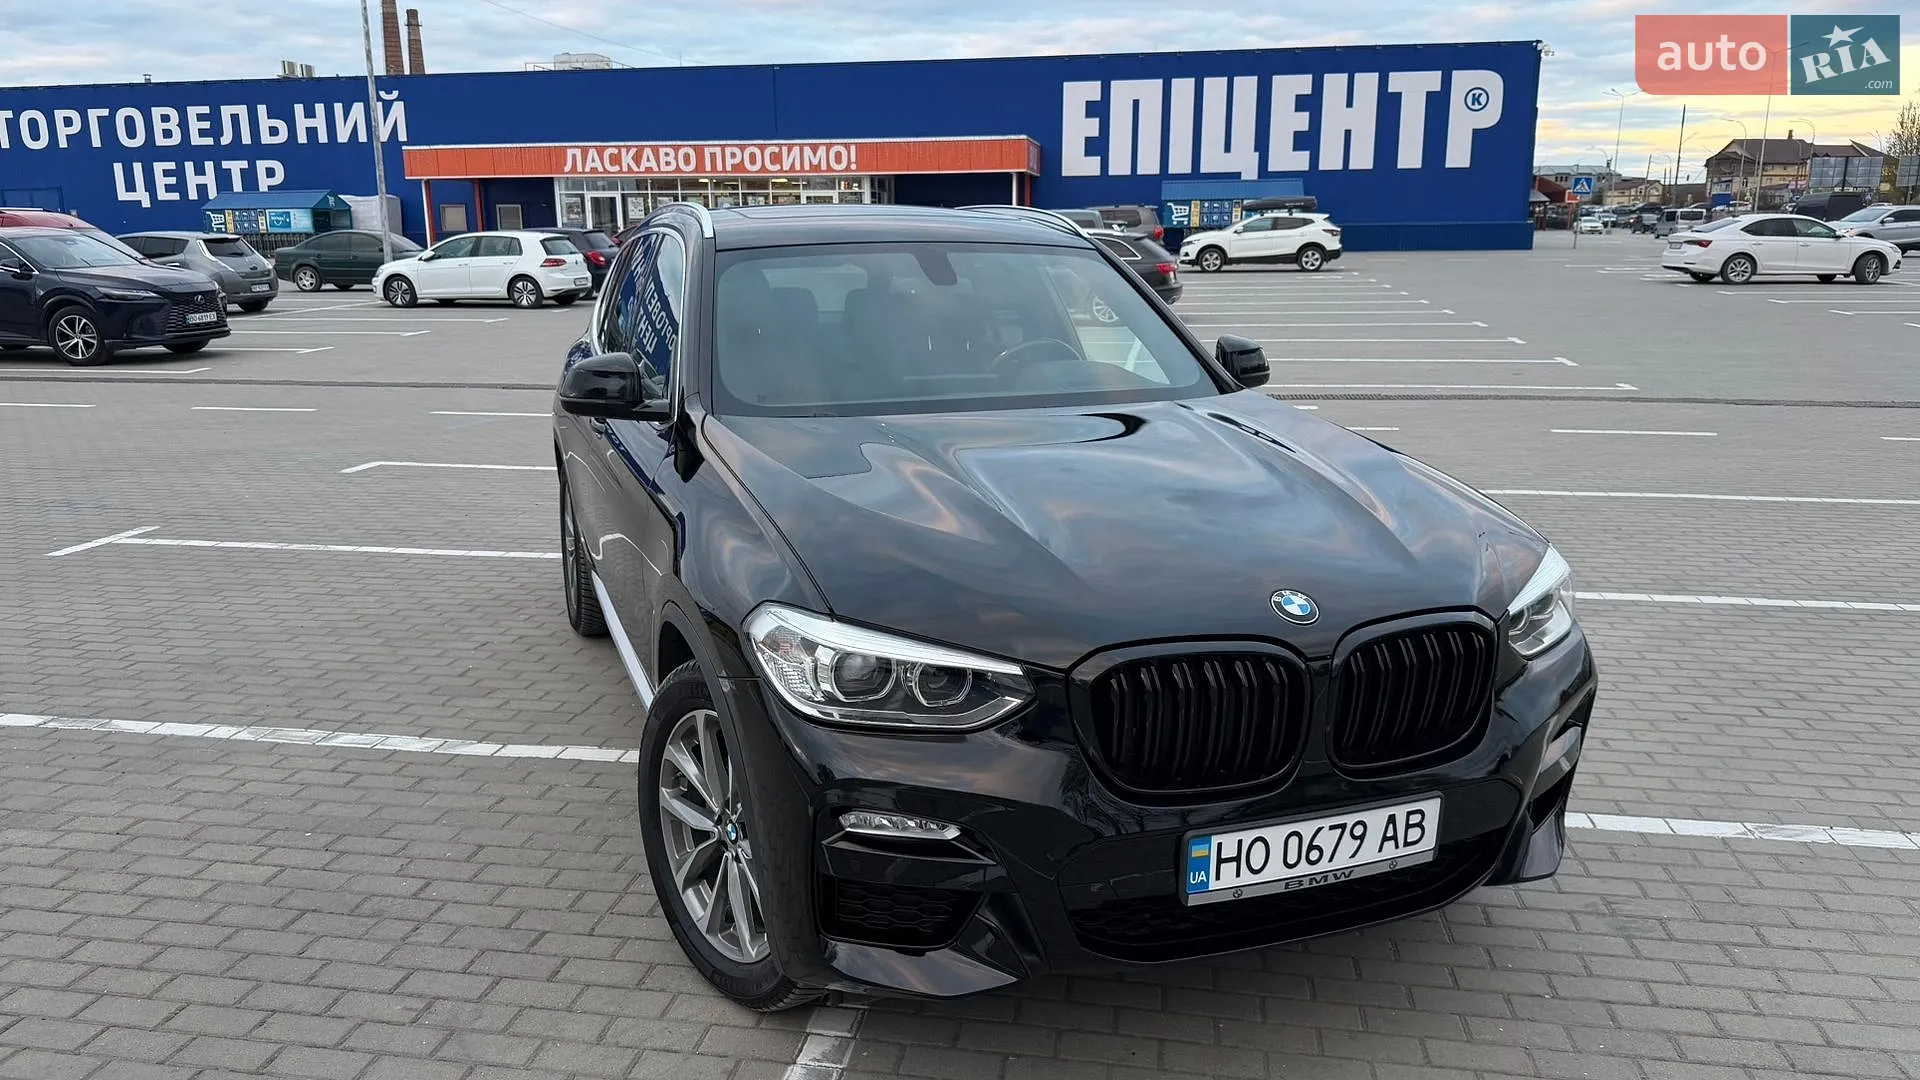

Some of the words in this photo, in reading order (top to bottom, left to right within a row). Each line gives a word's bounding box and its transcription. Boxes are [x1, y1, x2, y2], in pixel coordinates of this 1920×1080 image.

[0, 90, 408, 150] ТОРГОВЕЛЬНИЙ
[1062, 69, 1504, 180] ЕПІЦЕНТР
[564, 146, 697, 173] ЛАСКАВО
[704, 144, 857, 172] ПРОСИМО!
[113, 160, 285, 208] ЦЕНТР
[1214, 836, 1271, 881] HO
[1283, 819, 1368, 869] 0679
[1378, 808, 1426, 853] AB
[1190, 870, 1207, 883] UA
[1284, 869, 1354, 890] BMW
